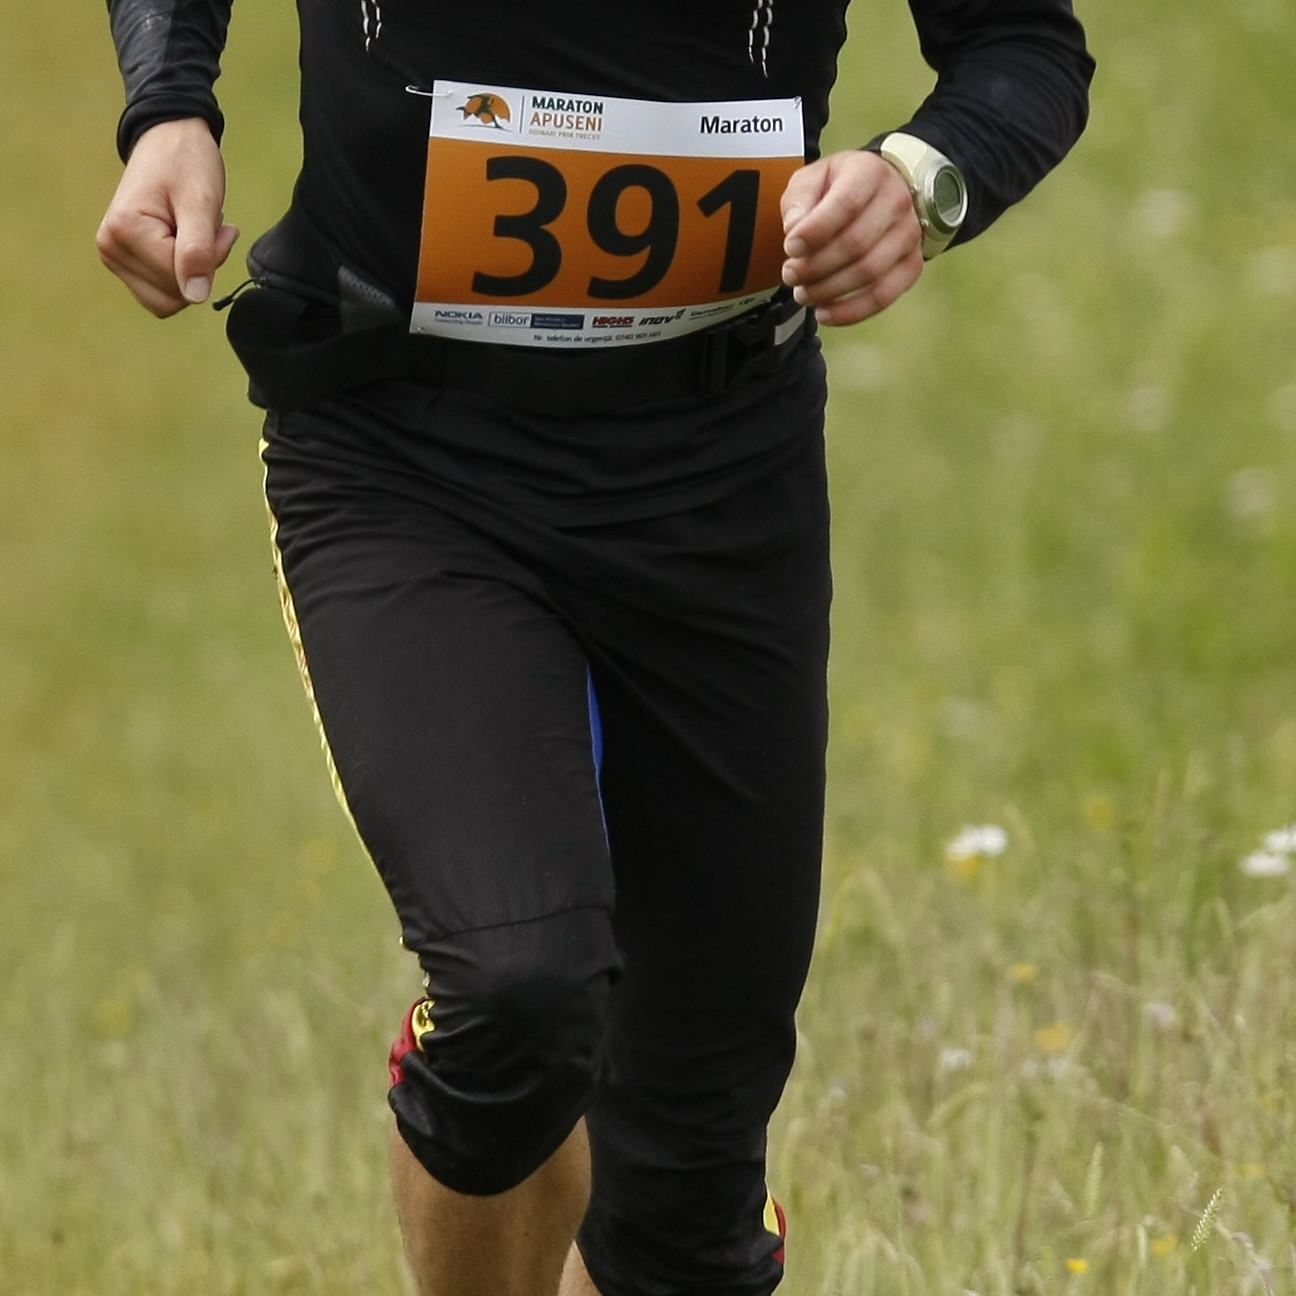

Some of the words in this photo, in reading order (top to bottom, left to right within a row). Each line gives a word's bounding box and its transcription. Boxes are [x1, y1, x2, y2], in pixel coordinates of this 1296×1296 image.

[531, 96, 604, 114] MARATON
[530, 111, 602, 131] APUSENI
[700, 115, 783, 134] Maraton
[471, 155, 761, 300] 391
[435, 310, 483, 319] NOKIA
[494, 313, 529, 325] bilbor
